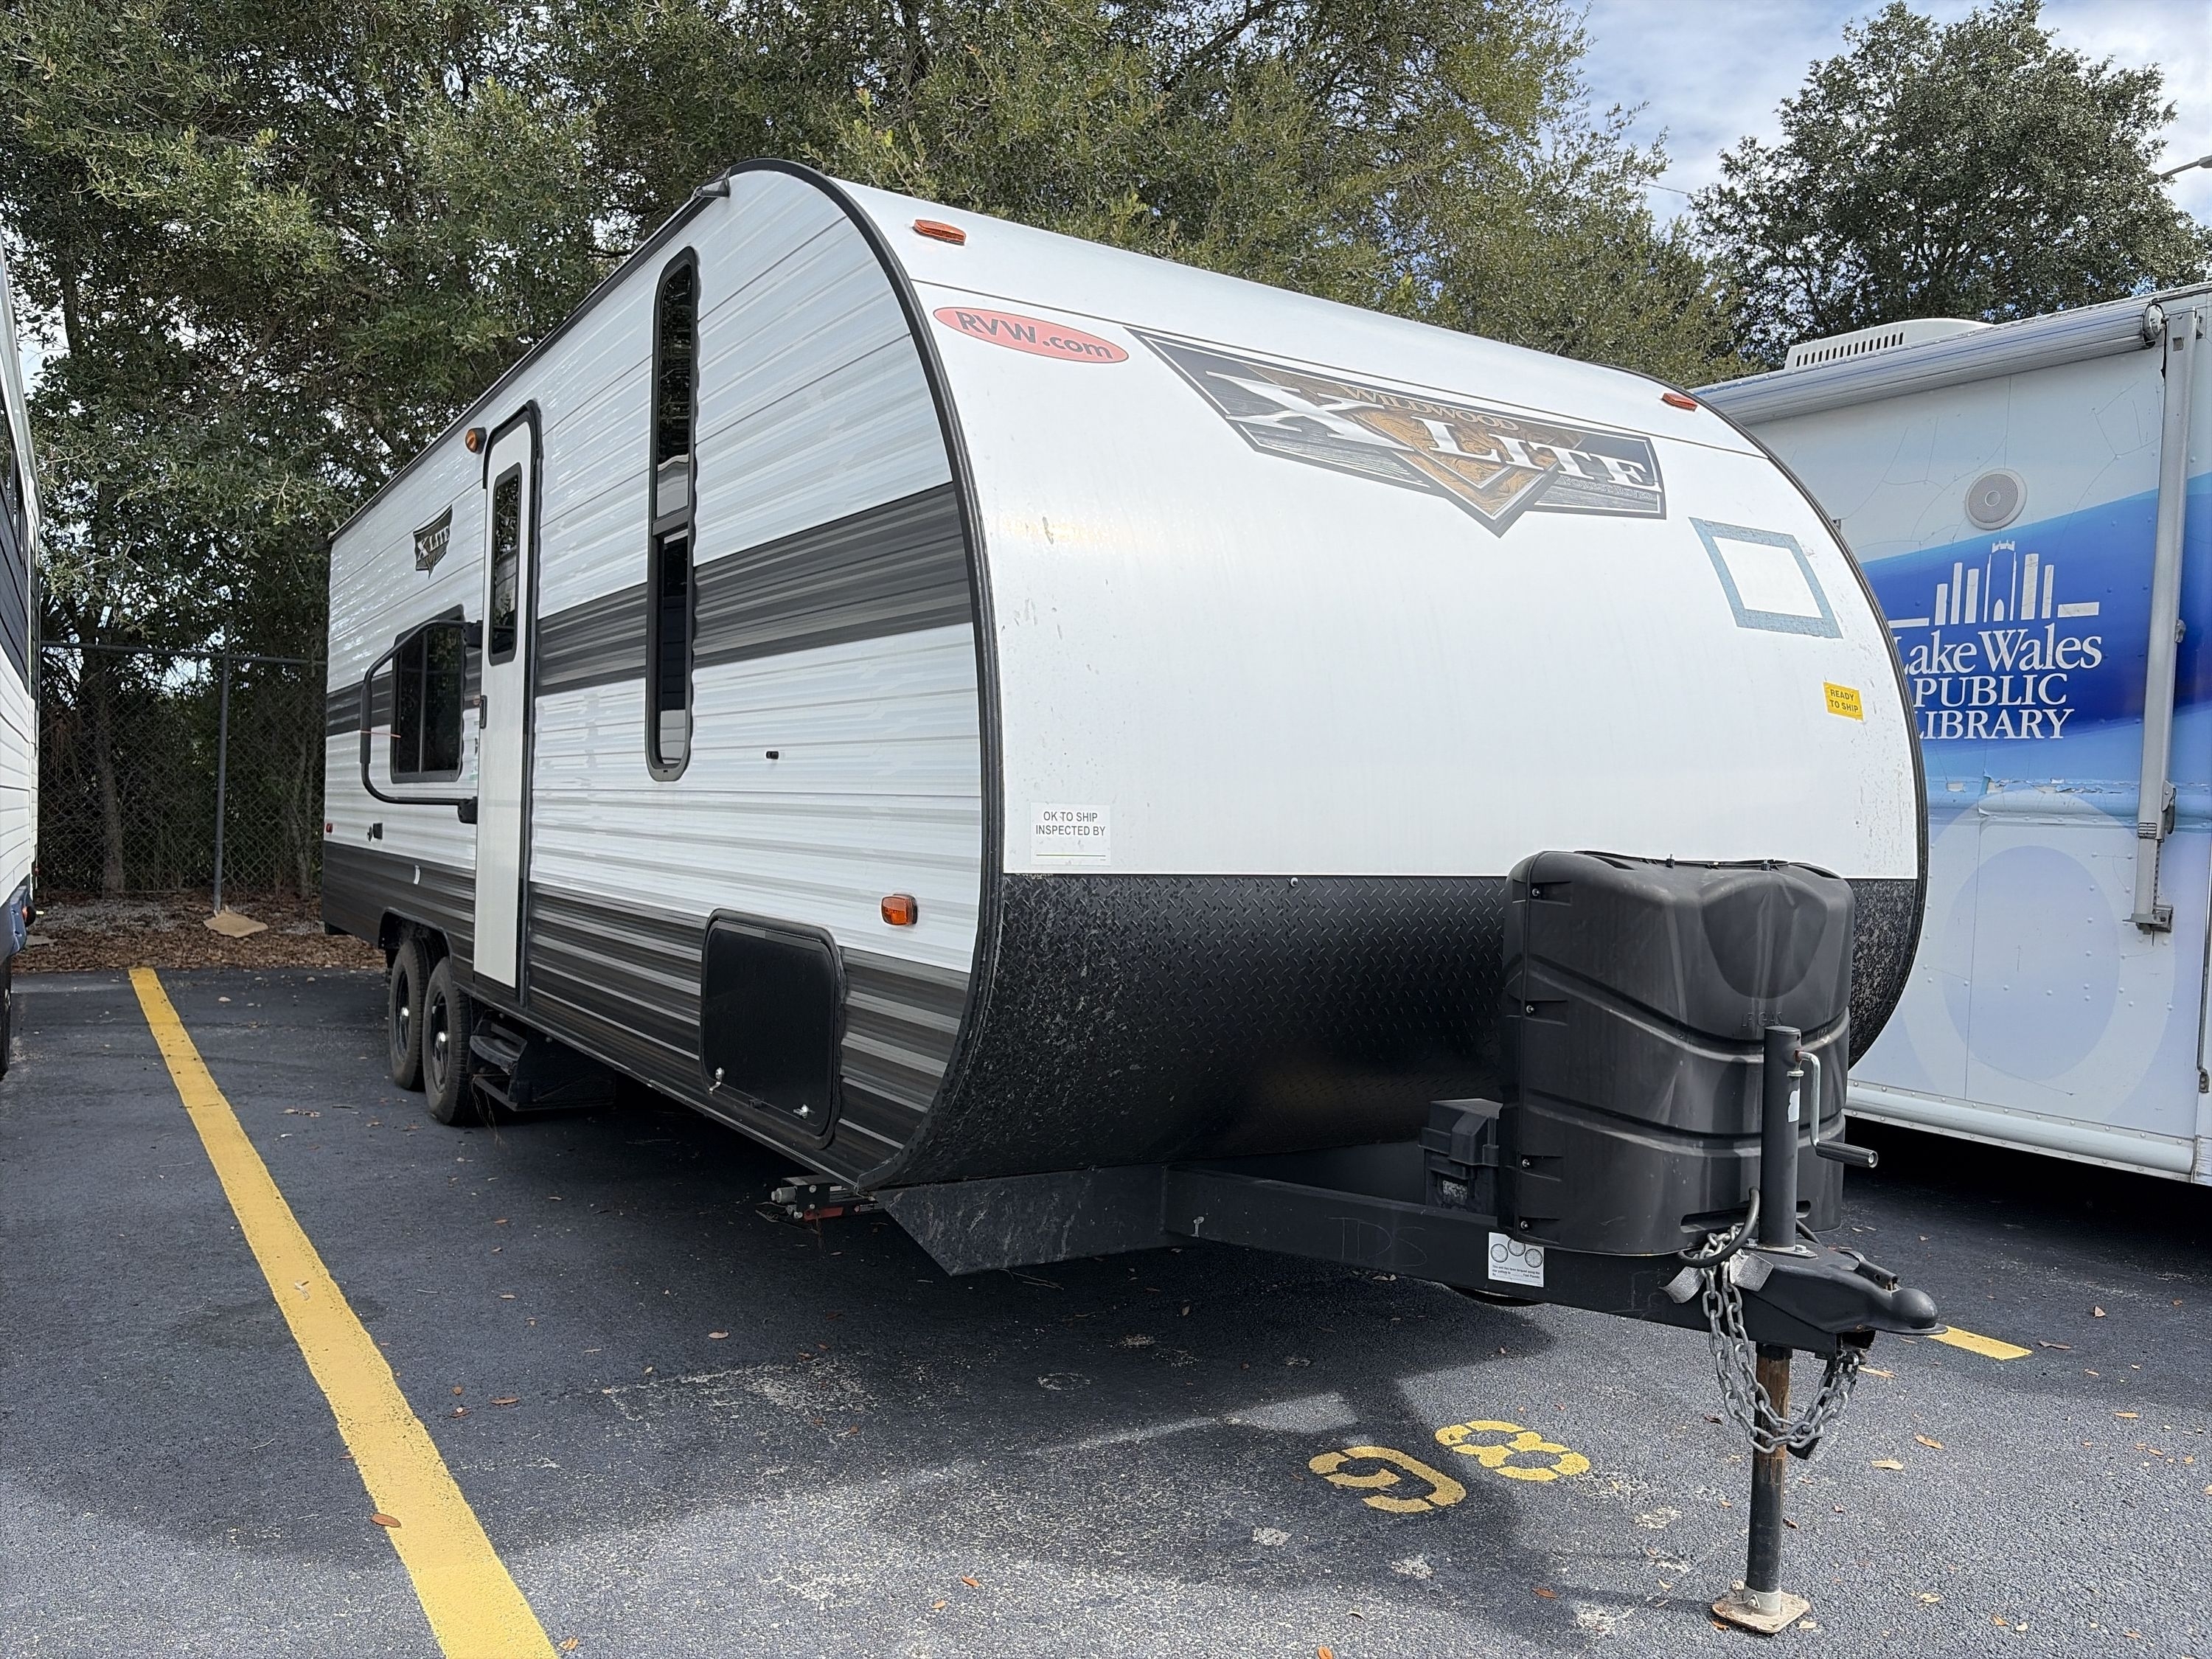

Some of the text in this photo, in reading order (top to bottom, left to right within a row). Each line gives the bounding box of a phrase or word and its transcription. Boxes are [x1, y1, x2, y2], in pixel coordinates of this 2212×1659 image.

[955, 310, 1113, 360] RVW.com
[1336, 383, 1520, 431] WILDWOOD
[1978, 622, 2102, 672] Wales
[1830, 689, 1854, 701] READY
[1913, 672, 2067, 708] PUBLIC
[1829, 699, 1859, 713] TO SHIP
[1043, 810, 1098, 823] OK TO SHIP
[1035, 824, 1106, 836] INSPECTED BY
